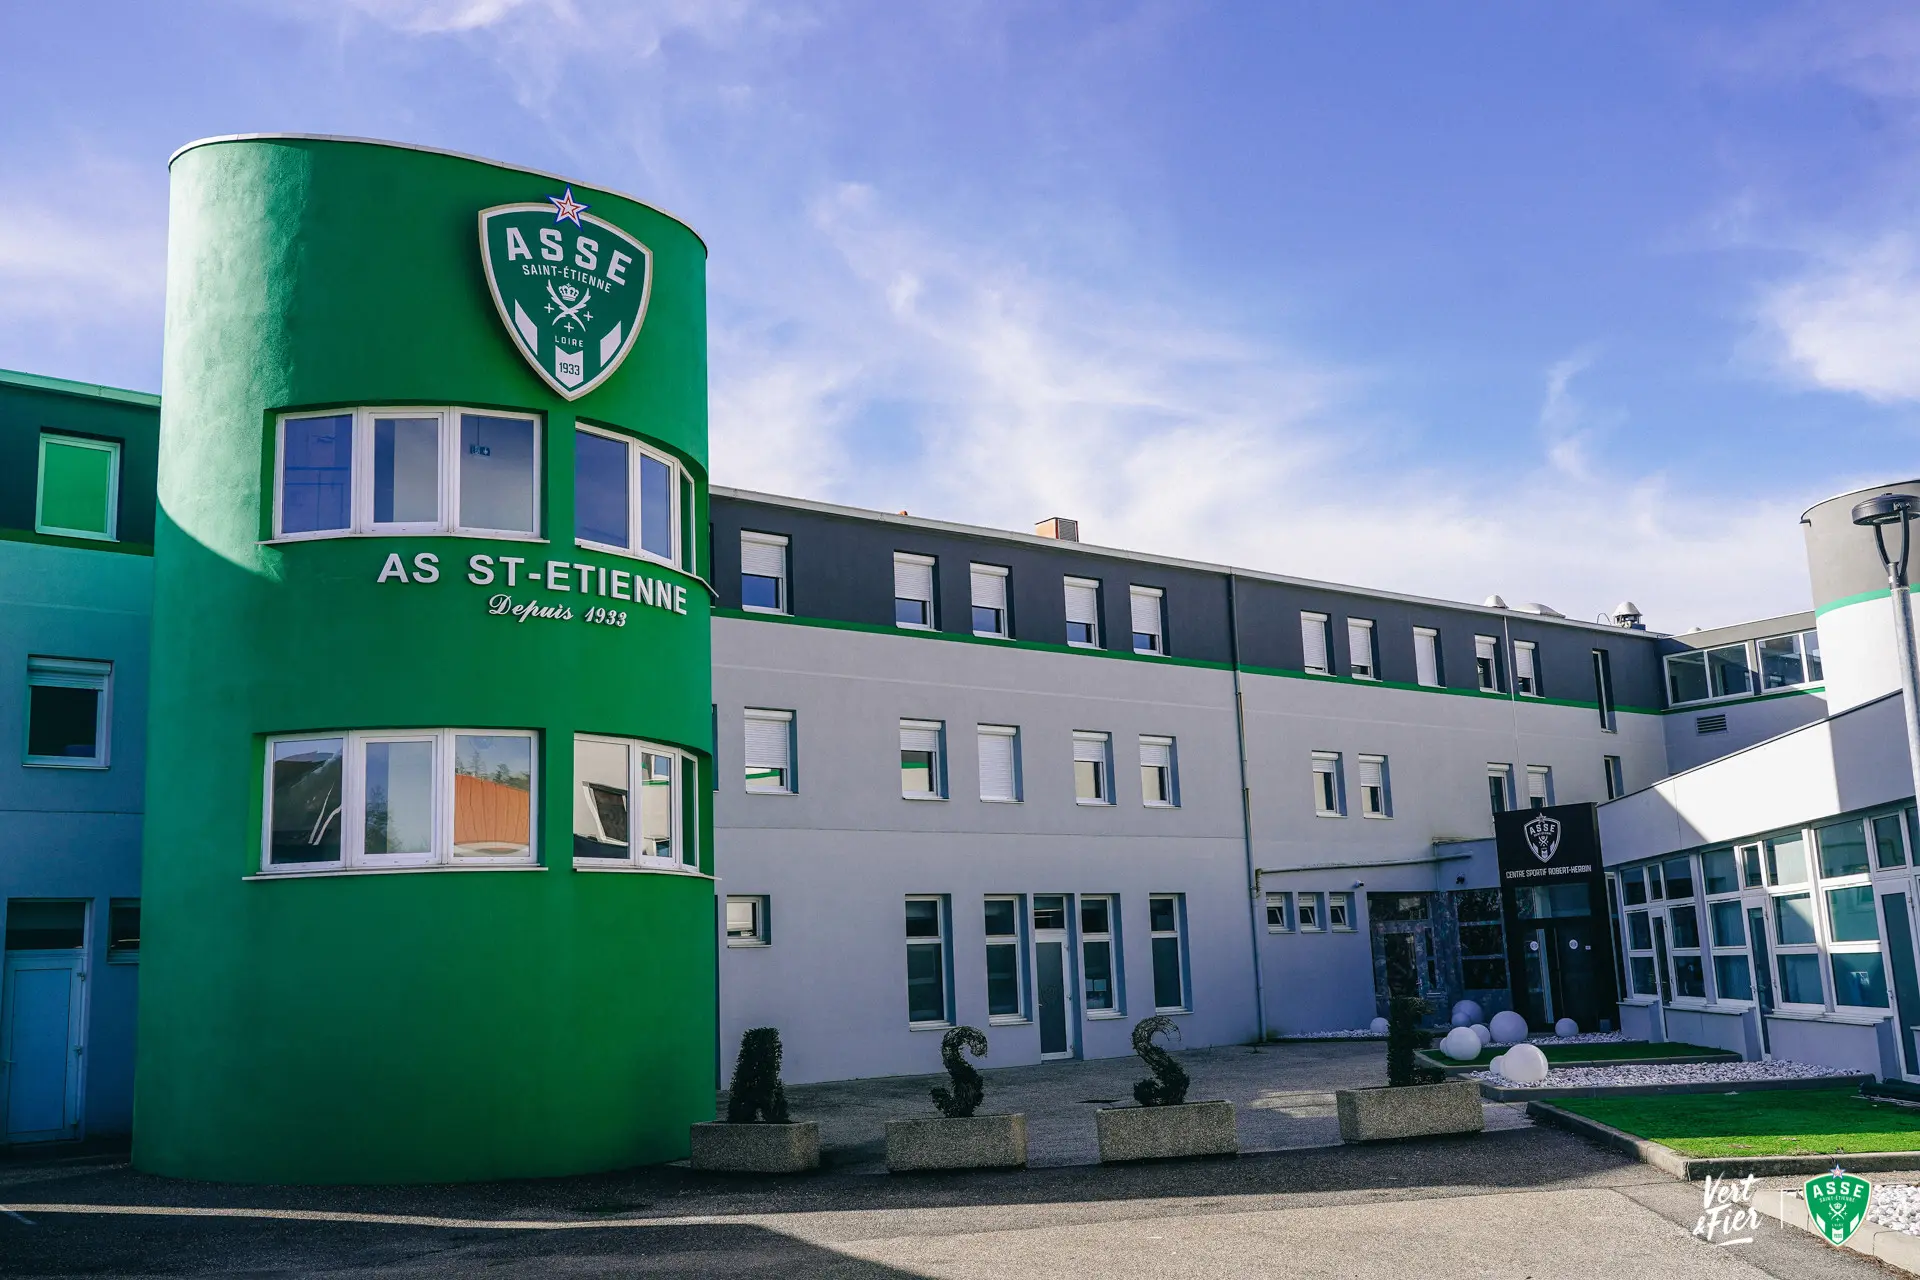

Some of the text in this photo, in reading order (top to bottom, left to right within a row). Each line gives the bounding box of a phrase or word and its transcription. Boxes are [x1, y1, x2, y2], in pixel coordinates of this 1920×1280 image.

[506, 227, 632, 286] ASSE
[522, 264, 612, 294] SAINT-ÉTIENNE
[554, 335, 584, 348] LOIRE
[559, 362, 580, 376] 1933
[377, 552, 688, 616] AS ST-ETIENNE
[488, 594, 627, 628] Depuis 1933
[1529, 823, 1556, 836] ASSE
